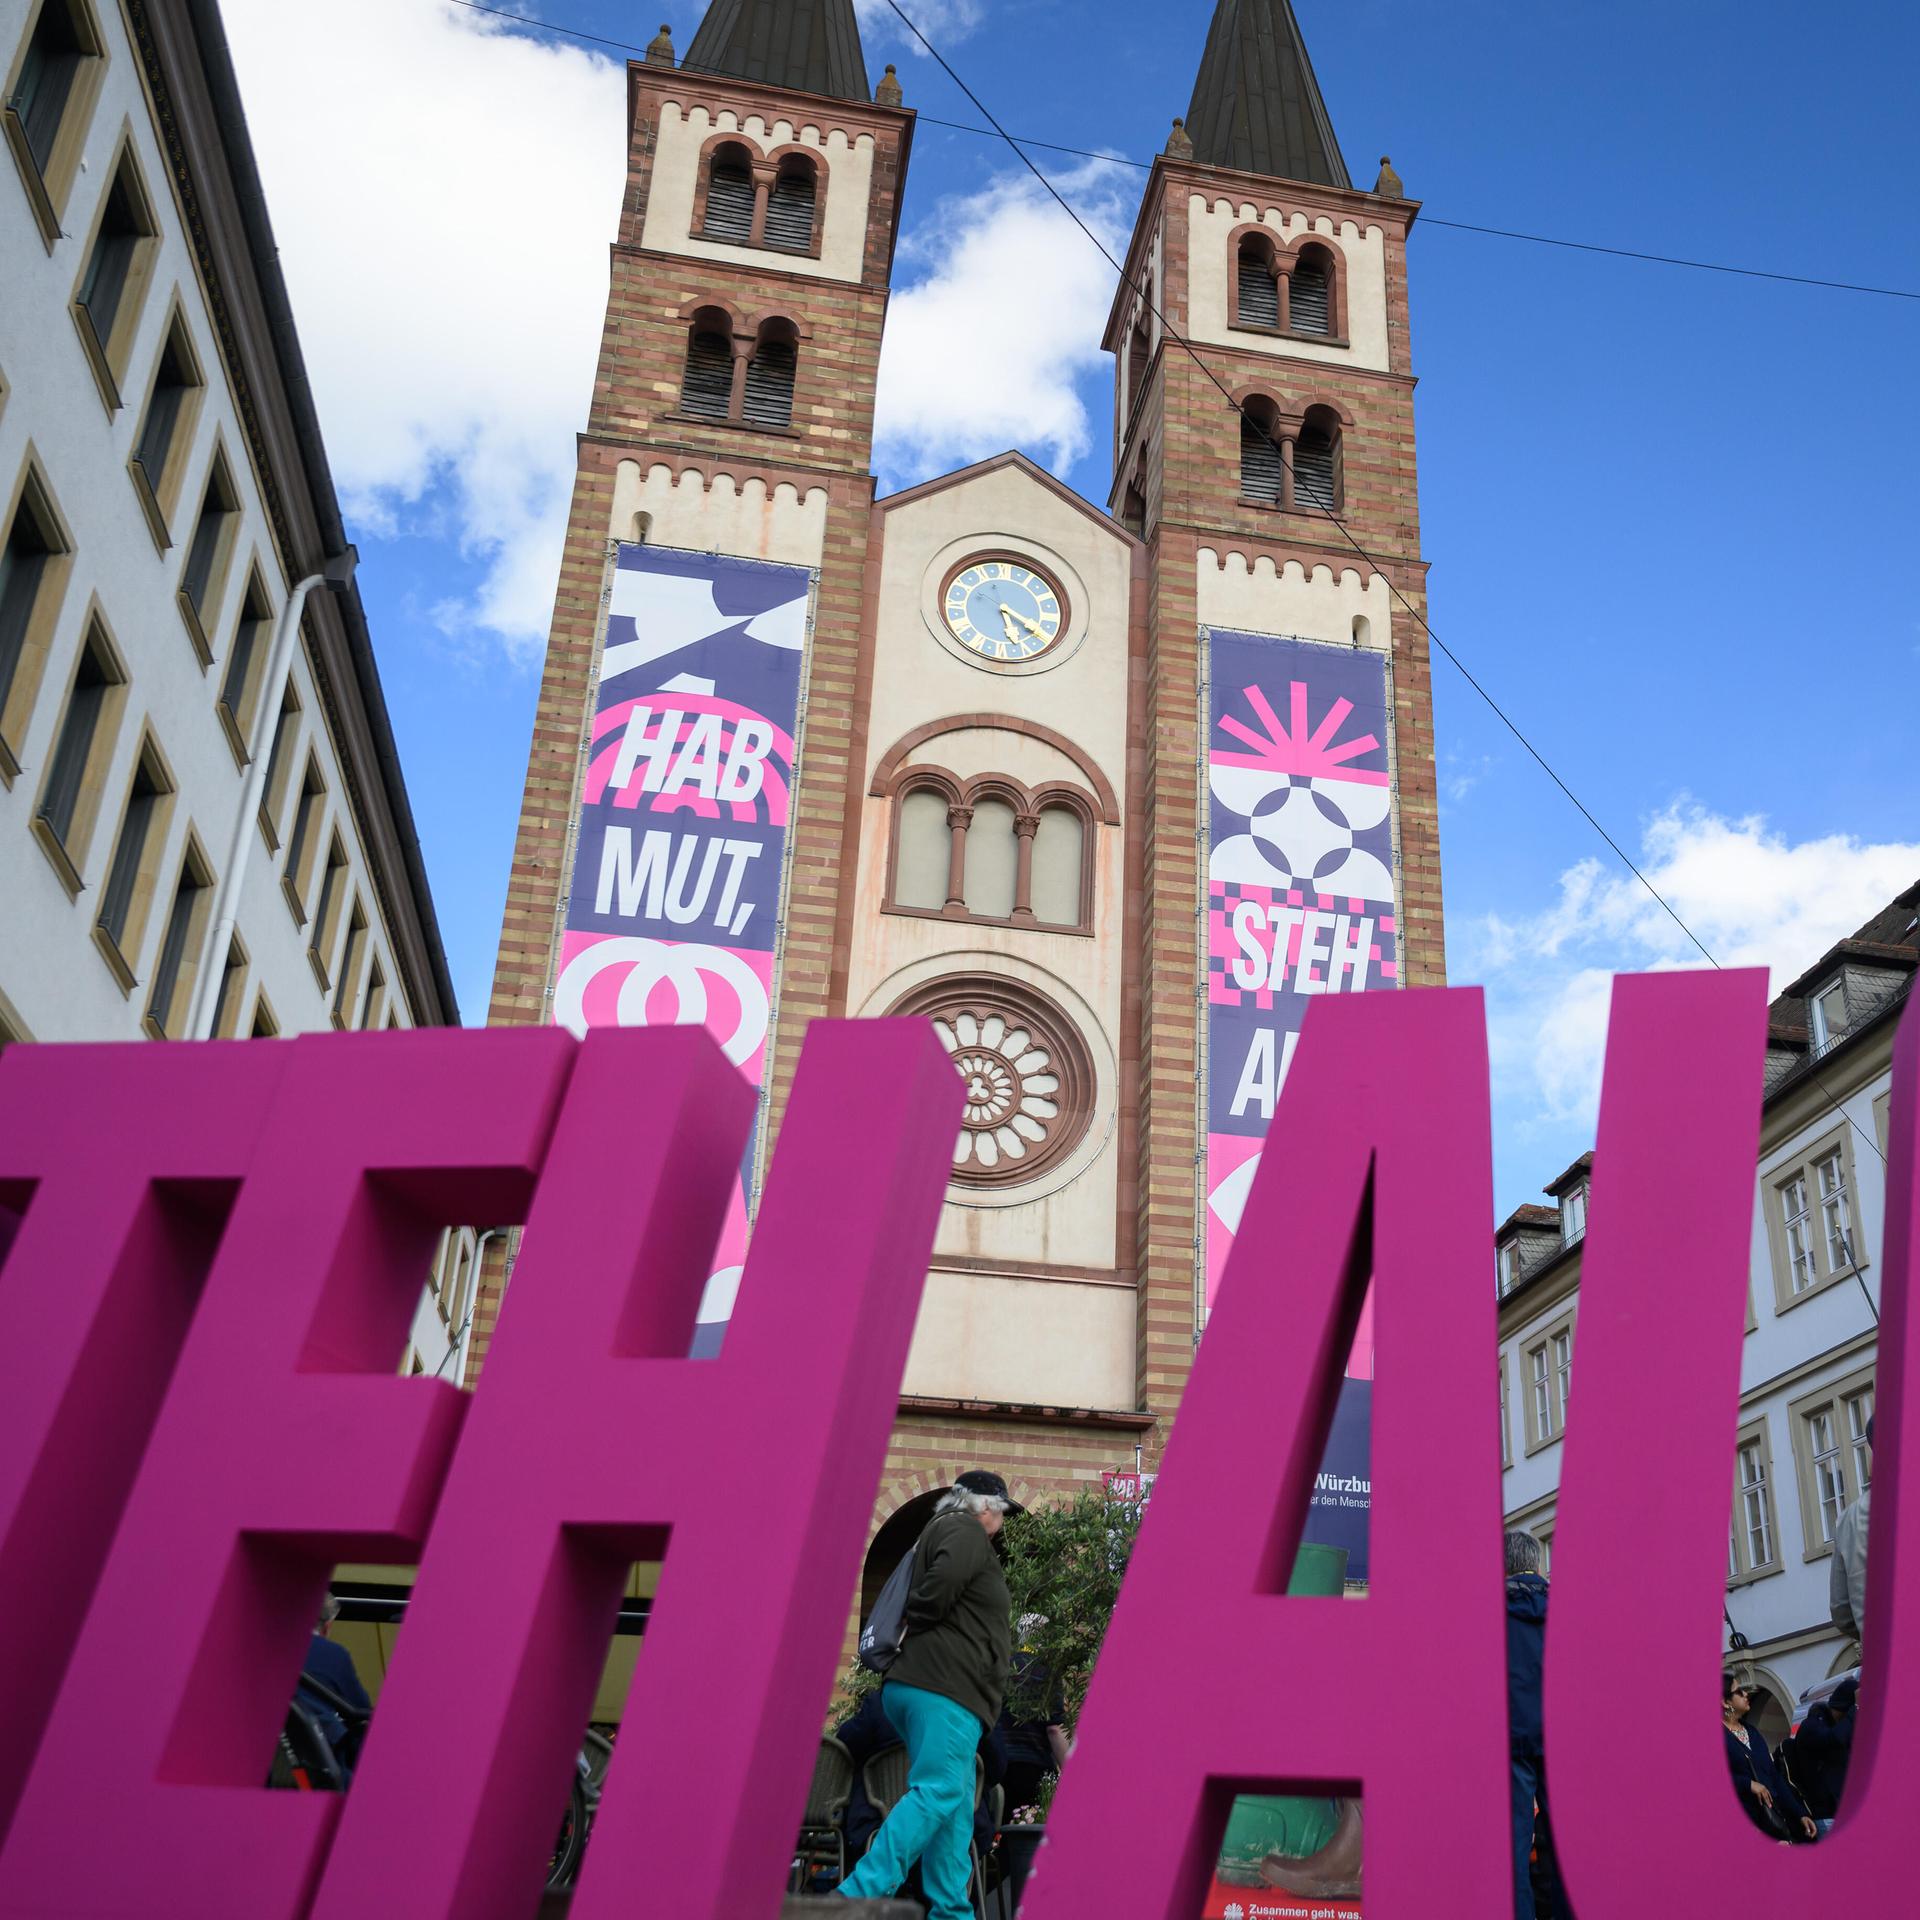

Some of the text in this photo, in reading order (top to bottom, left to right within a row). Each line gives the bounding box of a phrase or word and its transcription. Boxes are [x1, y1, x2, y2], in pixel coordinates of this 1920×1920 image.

[608, 704, 774, 803] HAB
[594, 825, 763, 936] MUT,
[1231, 901, 1375, 995] STEH
[1321, 1494, 1338, 1506] den
[1249, 1903, 1308, 1918] Zusammen
[1311, 1908, 1335, 1919] geht
